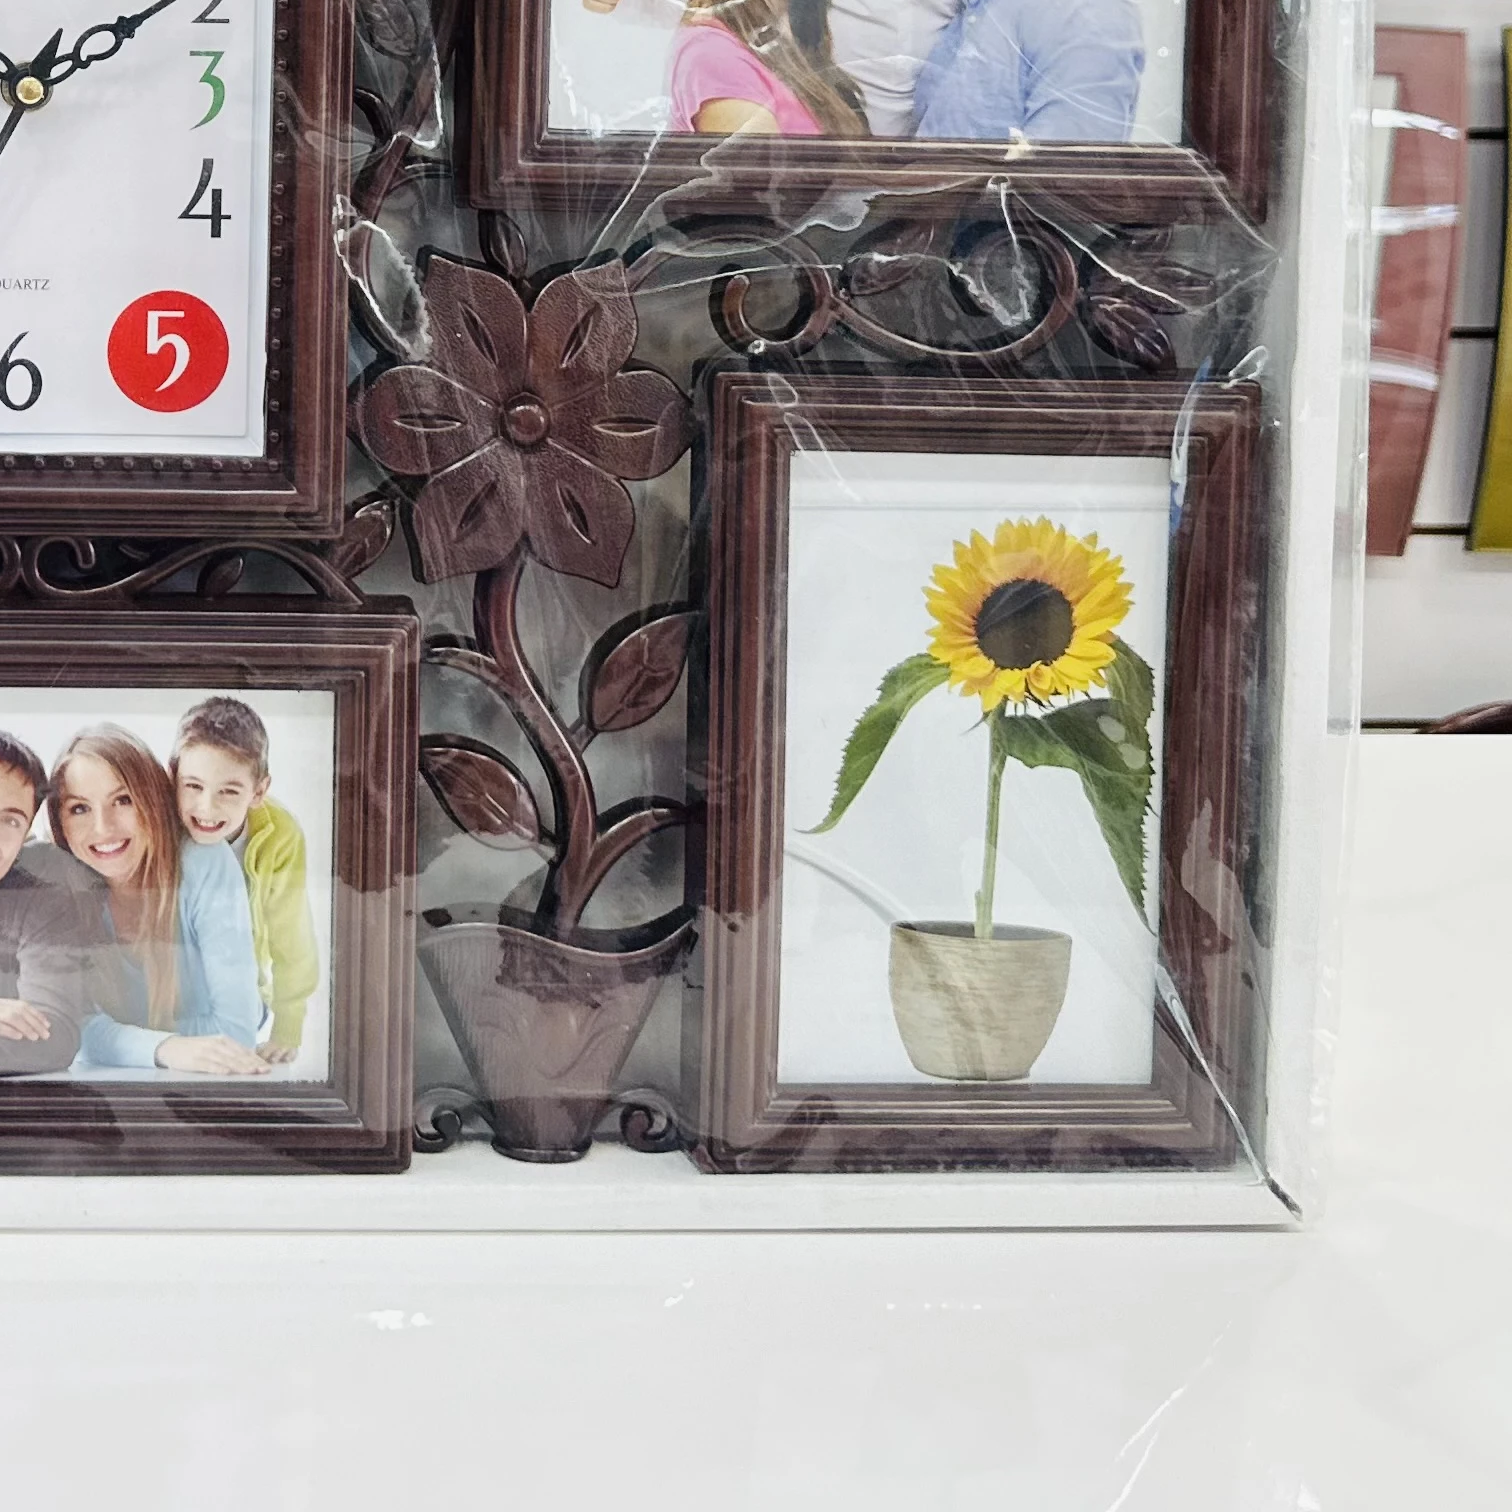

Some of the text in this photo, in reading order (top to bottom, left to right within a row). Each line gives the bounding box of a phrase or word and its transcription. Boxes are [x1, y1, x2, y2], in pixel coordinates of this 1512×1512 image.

[189, 51, 226, 130] 3
[177, 158, 231, 238] 4
[146, 310, 190, 392] 5
